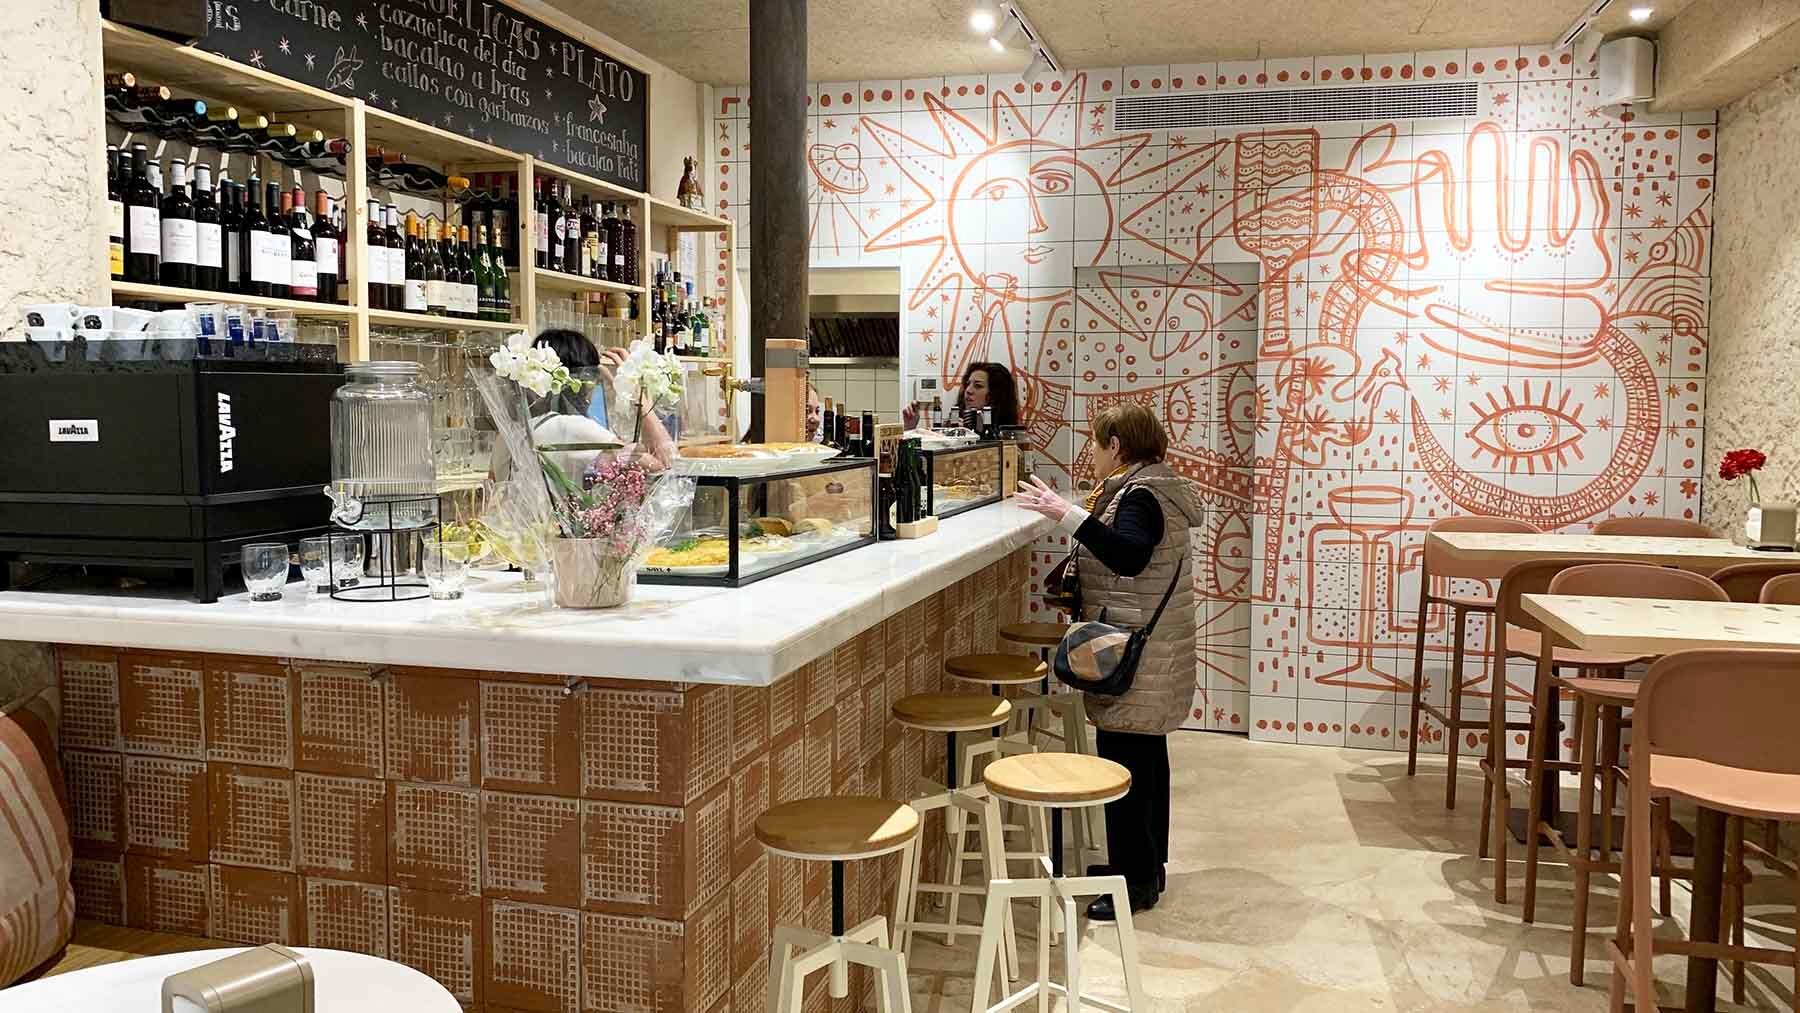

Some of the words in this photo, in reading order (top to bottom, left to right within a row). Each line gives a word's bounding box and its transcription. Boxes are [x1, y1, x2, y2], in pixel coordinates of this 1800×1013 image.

[379, 2, 468, 53] cazuelica
[474, 39, 498, 67] del
[379, 25, 465, 81] bacalao
[491, 69, 530, 107] bras
[382, 61, 440, 95] callos
[445, 84, 474, 109] con
[479, 97, 549, 134] garbanzos
[561, 41, 634, 102] PLATO
[566, 112, 638, 159] francesinha
[566, 139, 613, 172] bacalao
[58, 424, 88, 435] LAVAZZA
[217, 392, 236, 473] LAVAZZA
